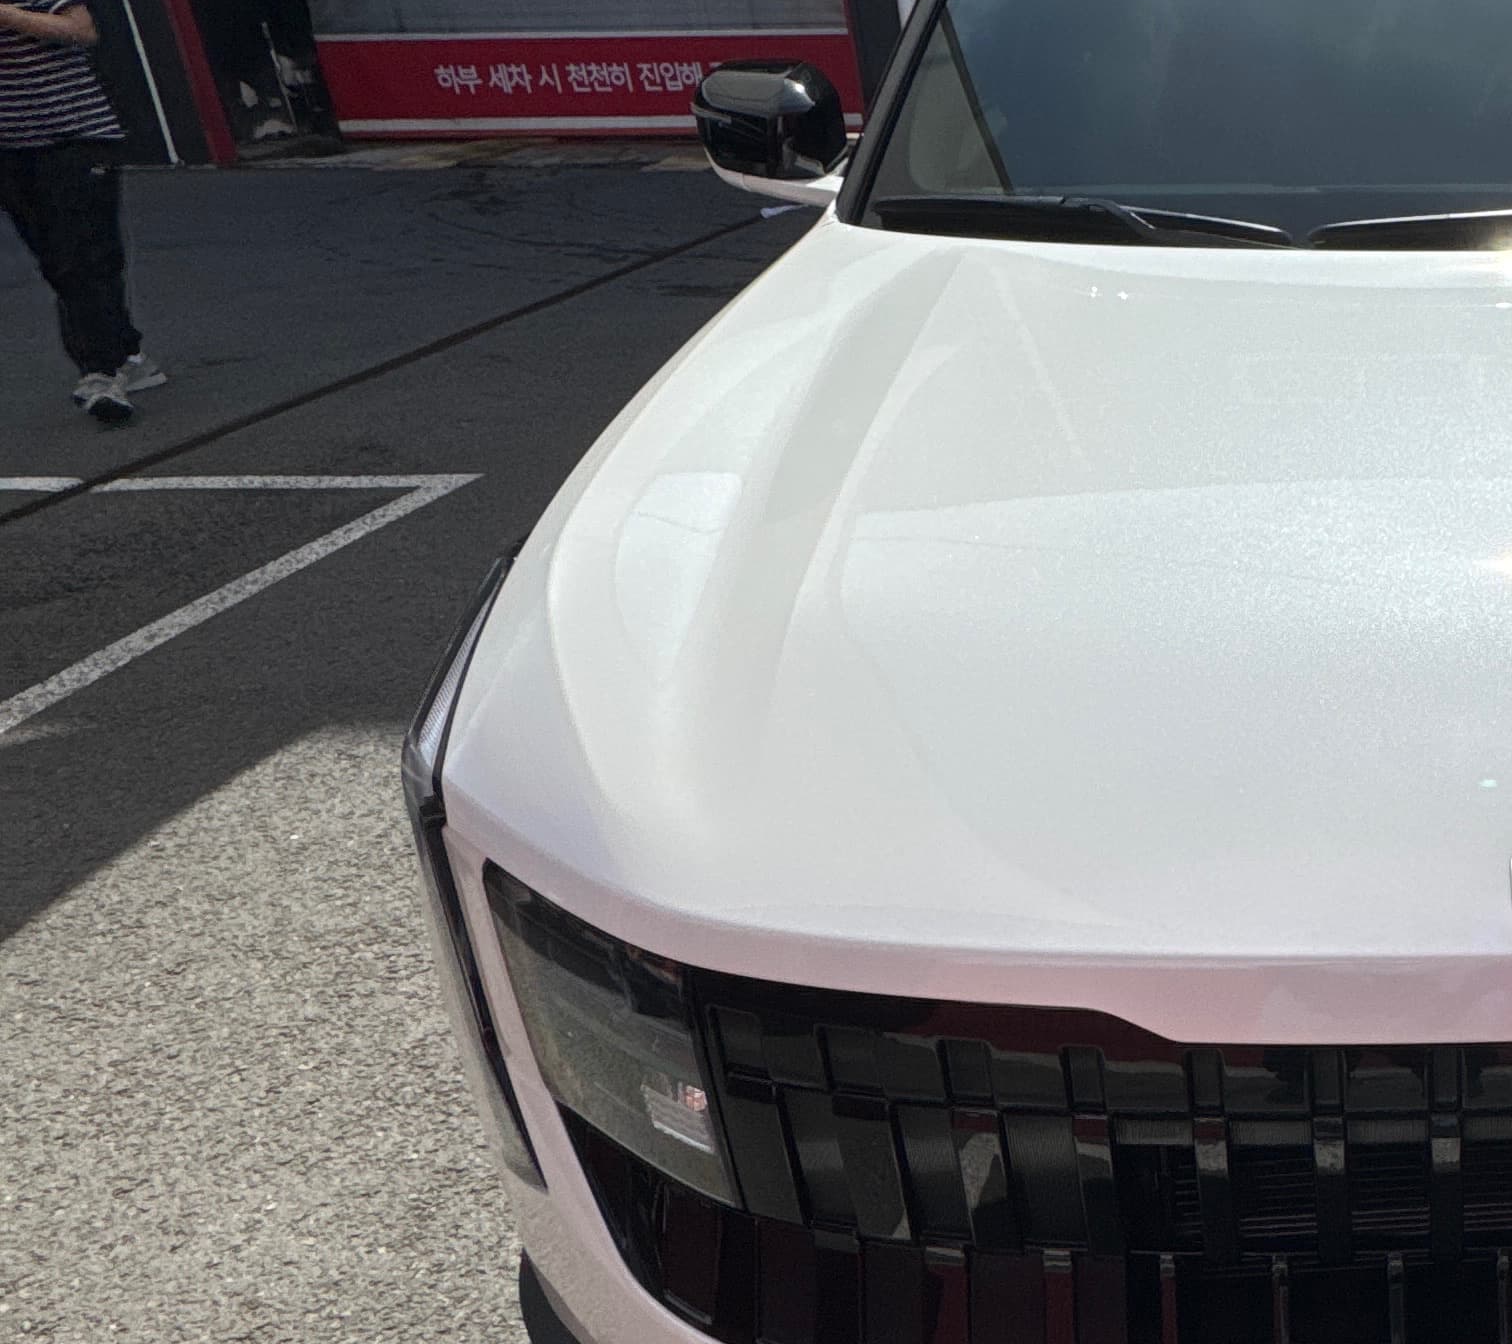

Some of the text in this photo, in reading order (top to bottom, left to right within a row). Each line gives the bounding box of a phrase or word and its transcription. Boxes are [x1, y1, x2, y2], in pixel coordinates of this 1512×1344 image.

[434, 63, 483, 95] 하부
[488, 63, 532, 94] 세차
[538, 62, 563, 94] 시
[565, 62, 633, 94] 천천히
